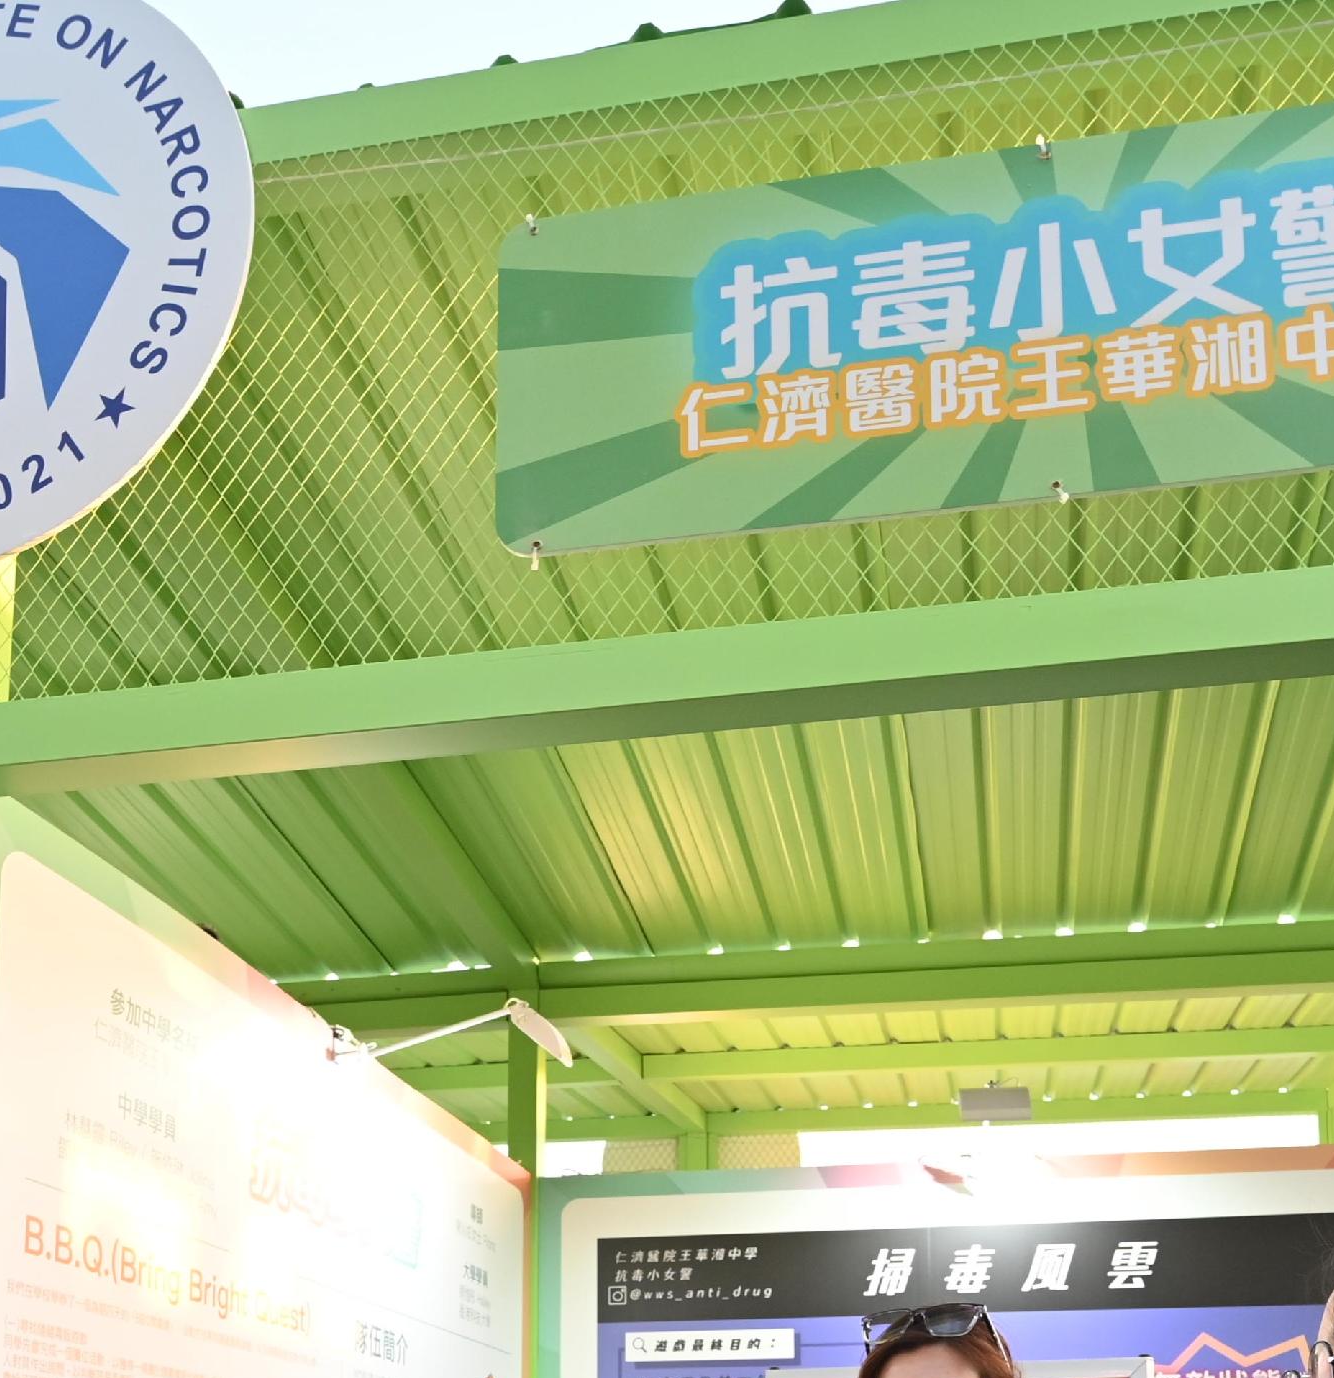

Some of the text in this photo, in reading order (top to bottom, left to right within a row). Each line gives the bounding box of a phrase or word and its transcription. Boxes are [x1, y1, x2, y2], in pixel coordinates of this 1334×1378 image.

[56, 14, 128, 69] ON
[124, 61, 210, 374] NARCOTICS
[110, 988, 197, 1050] 參加中學名
[189, 1269, 249, 1319] Bright
[630, 1286, 772, 1301] @wws_anti_drug
[863, 1241, 1159, 1298] 掃毒風雲
